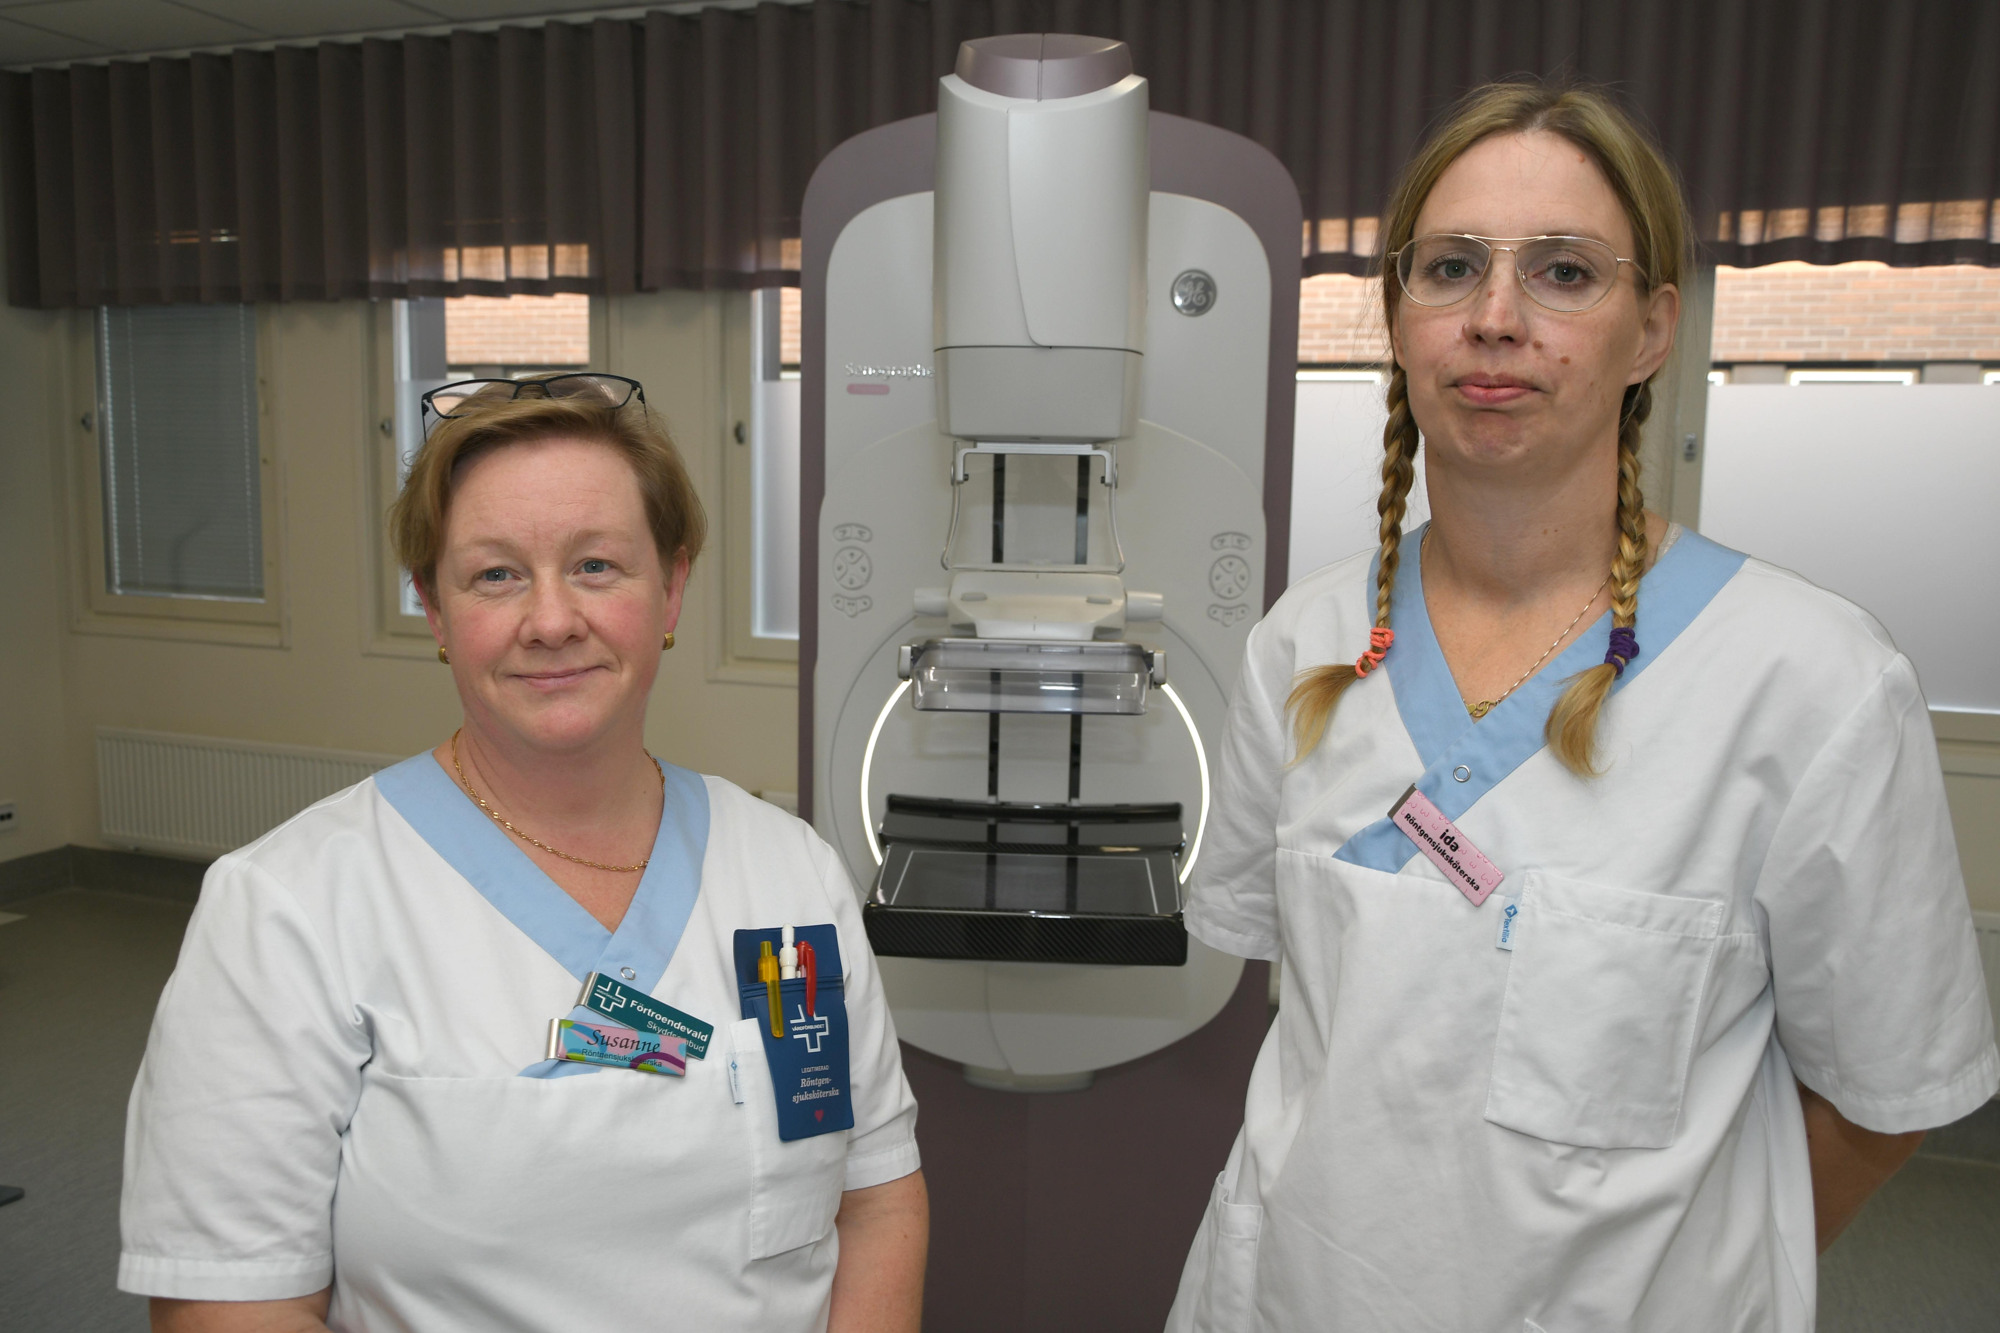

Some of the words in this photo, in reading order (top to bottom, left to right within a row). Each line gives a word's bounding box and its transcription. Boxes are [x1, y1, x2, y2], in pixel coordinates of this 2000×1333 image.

[1404, 813, 1480, 891] Röntgensjuksköterska
[1439, 829, 1459, 852] ida
[630, 999, 708, 1042] Förtroendevald
[586, 1029, 661, 1053] Susanne
[800, 1077, 832, 1087] Röntgen-
[792, 1087, 840, 1104] sjuksköterska
